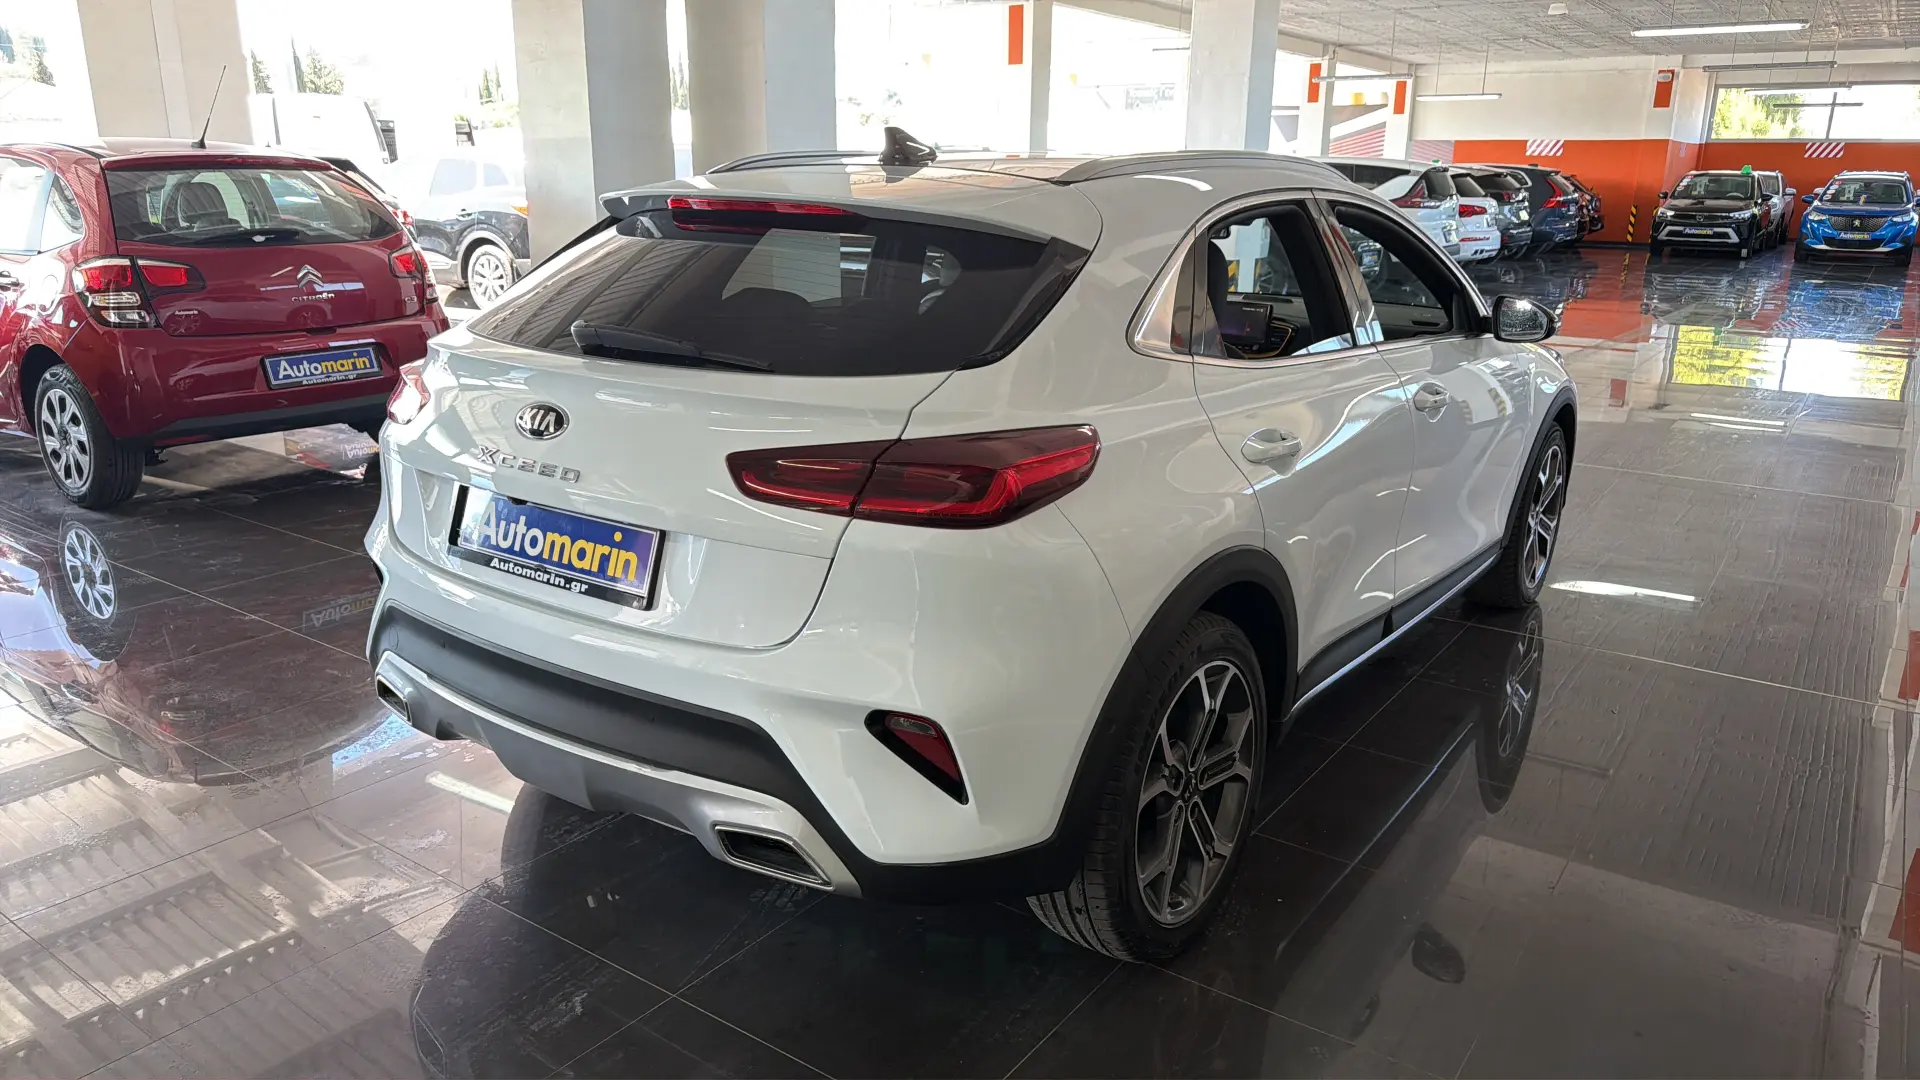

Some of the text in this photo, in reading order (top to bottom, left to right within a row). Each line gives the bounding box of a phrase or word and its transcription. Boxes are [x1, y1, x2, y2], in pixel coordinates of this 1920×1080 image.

[1684, 227, 1714, 236] Automarin
[1839, 232, 1870, 240] Automarin
[278, 352, 371, 379] Automarin
[302, 374, 357, 385] Automarin.gr
[518, 407, 557, 433] KIA
[477, 446, 581, 484] XCEED
[478, 501, 639, 582] Automarin
[490, 557, 589, 593] Automarin.gr
